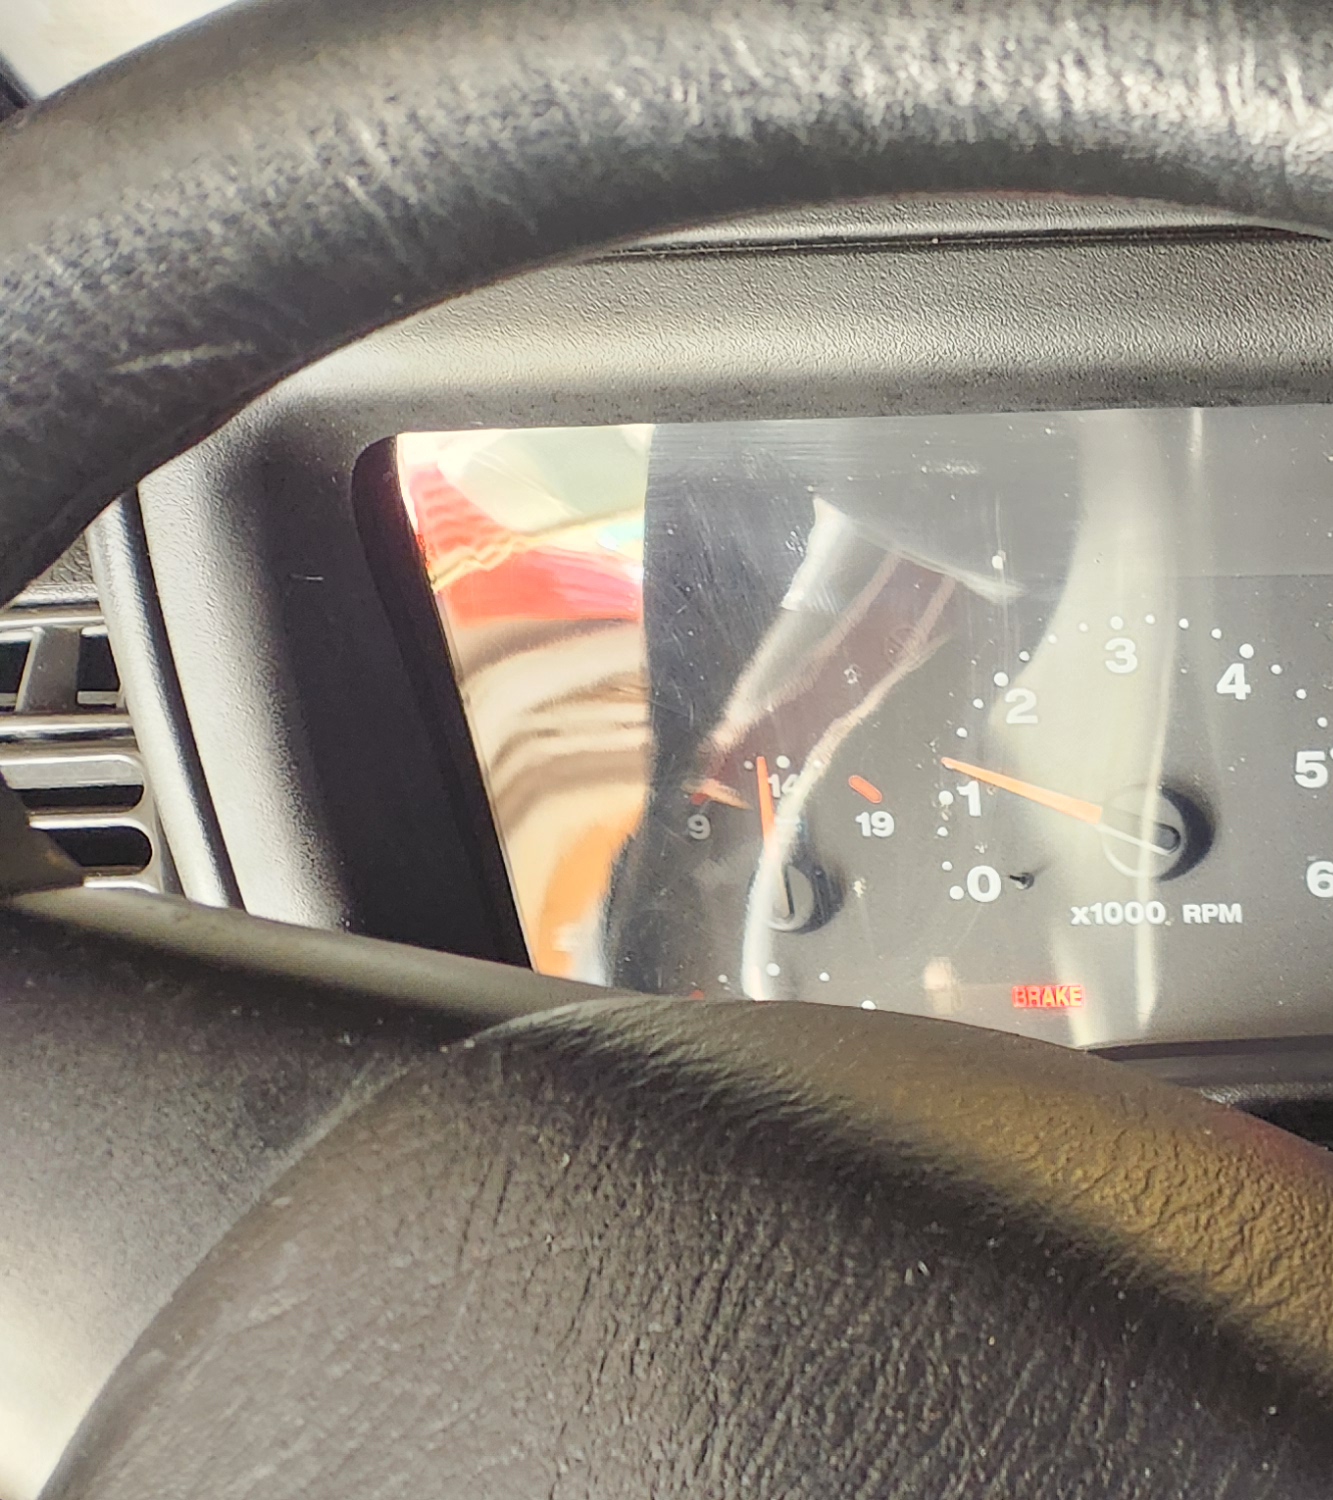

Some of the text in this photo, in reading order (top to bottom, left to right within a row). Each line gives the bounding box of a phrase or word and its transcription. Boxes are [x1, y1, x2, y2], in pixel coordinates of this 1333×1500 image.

[1104, 638, 1138, 674] 3
[1216, 664, 1251, 700] 4
[1005, 688, 1039, 724] 2
[1295, 751, 1329, 788] 5
[956, 780, 982, 817] 1
[687, 814, 711, 840] 9
[855, 811, 895, 838] 19
[966, 865, 1002, 902] 0
[1070, 902, 1243, 926] x1000 RPM
[1012, 984, 1084, 1009] BRAKE
